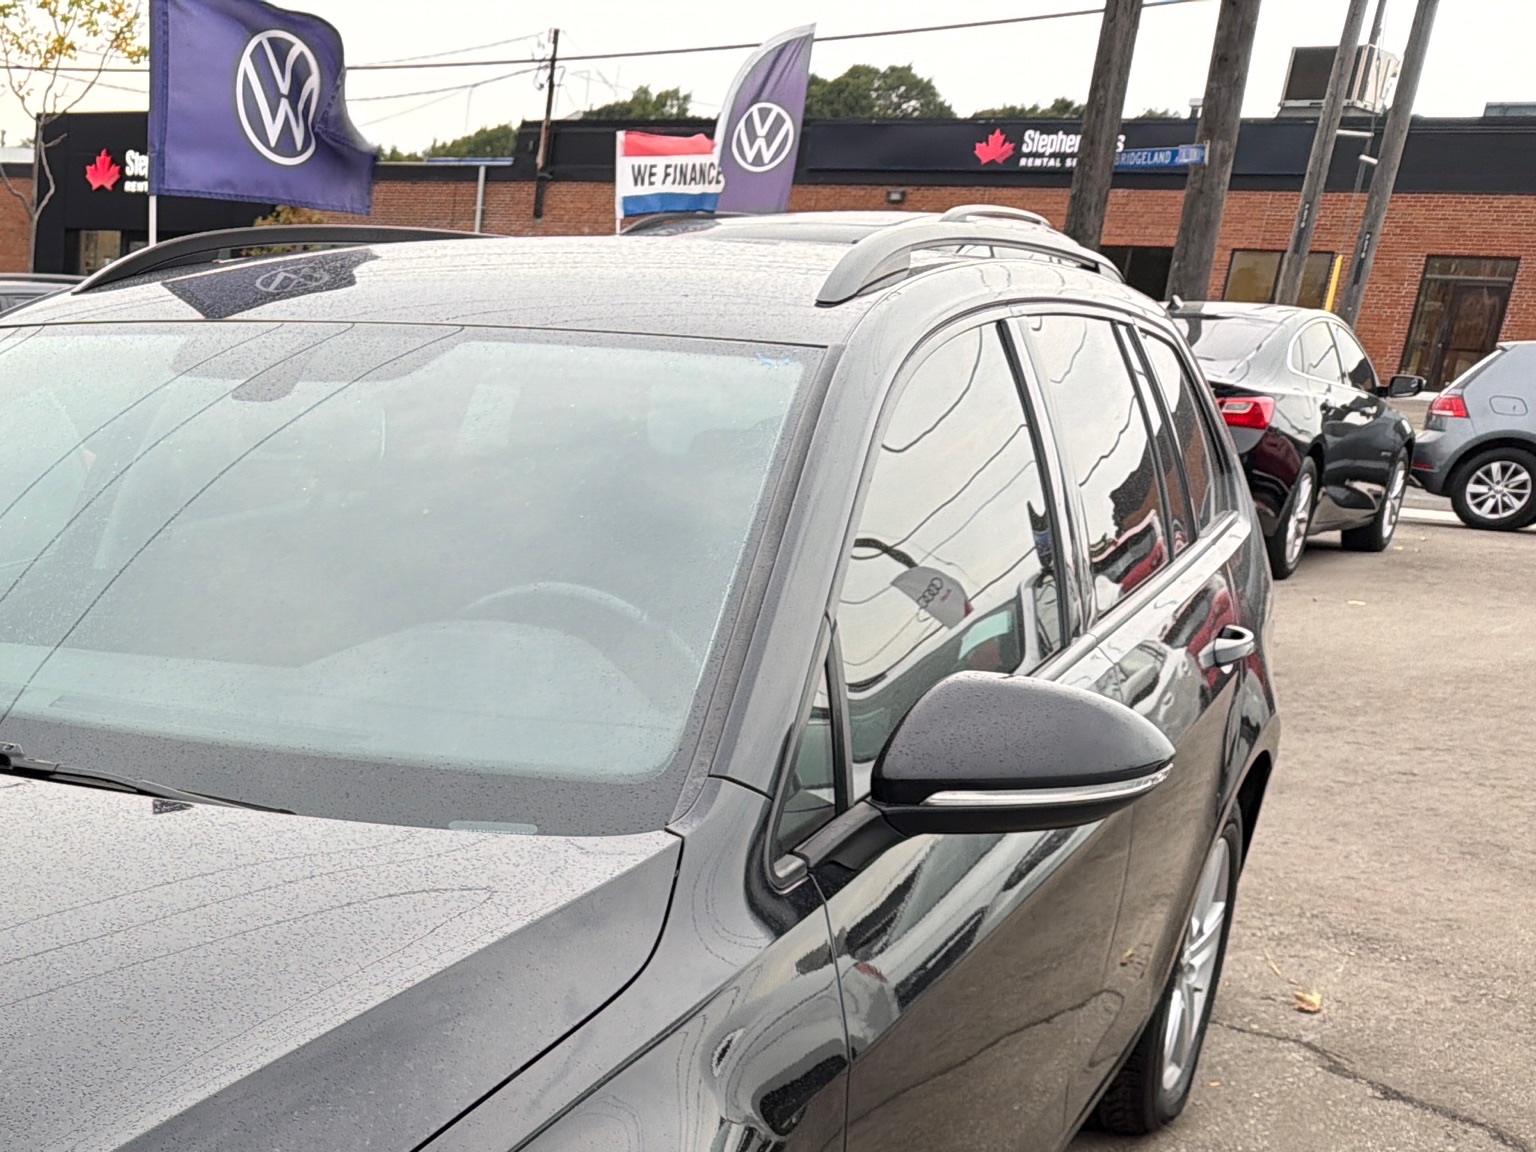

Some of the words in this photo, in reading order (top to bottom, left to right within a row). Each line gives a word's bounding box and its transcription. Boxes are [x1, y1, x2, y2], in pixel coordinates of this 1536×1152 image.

[1019, 157, 1061, 167] RENTAL
[631, 164, 657, 186] WE
[662, 162, 722, 186] FINANCE
